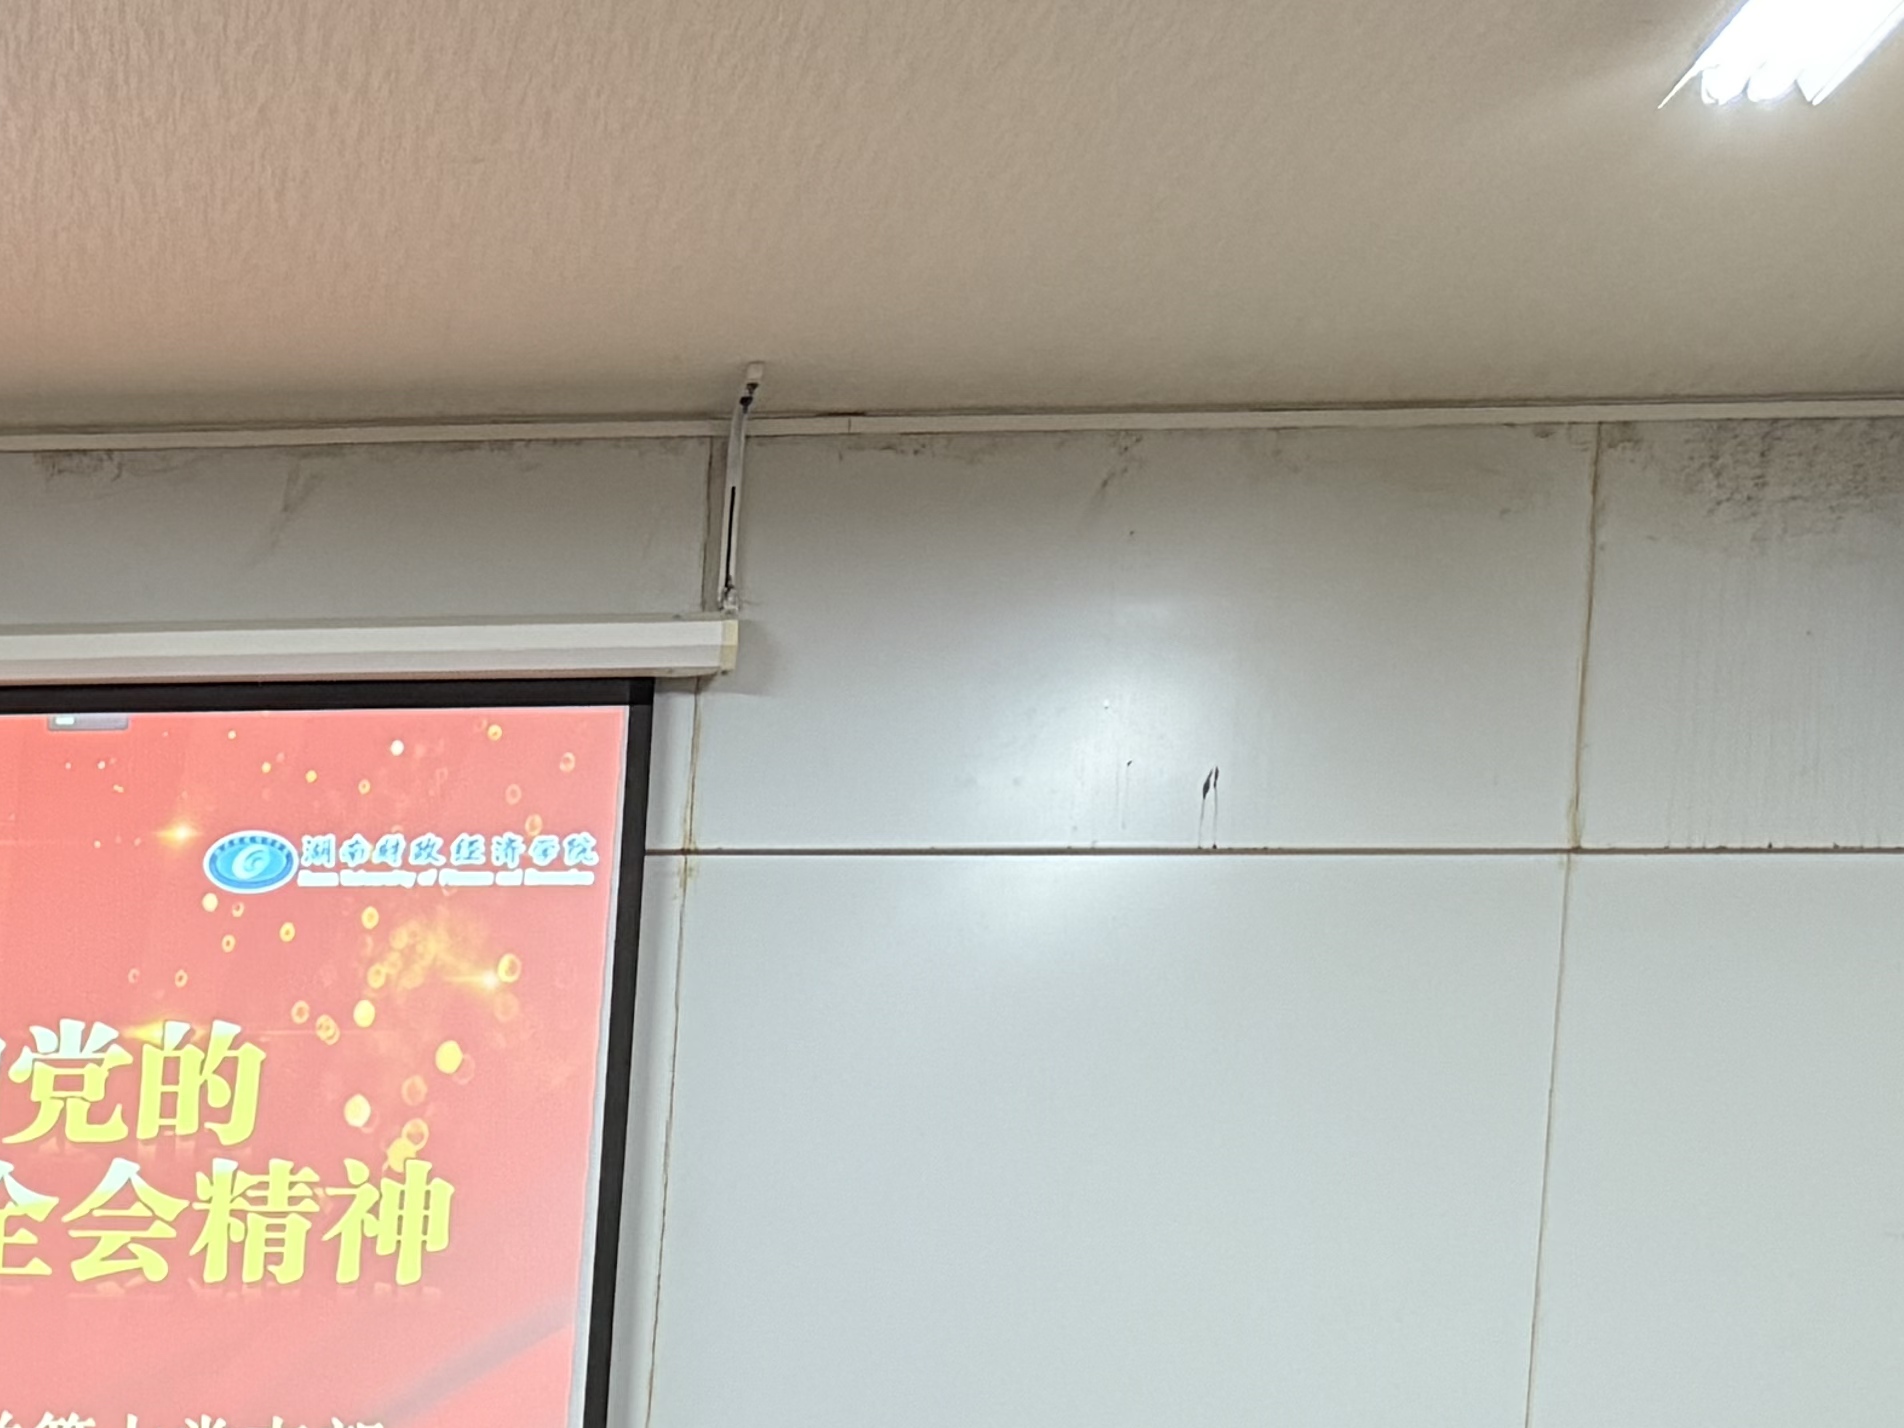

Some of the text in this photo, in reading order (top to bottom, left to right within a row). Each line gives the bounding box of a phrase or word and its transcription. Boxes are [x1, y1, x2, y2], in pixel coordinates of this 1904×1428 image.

[301, 832, 599, 868] 湖南财政经济学院
